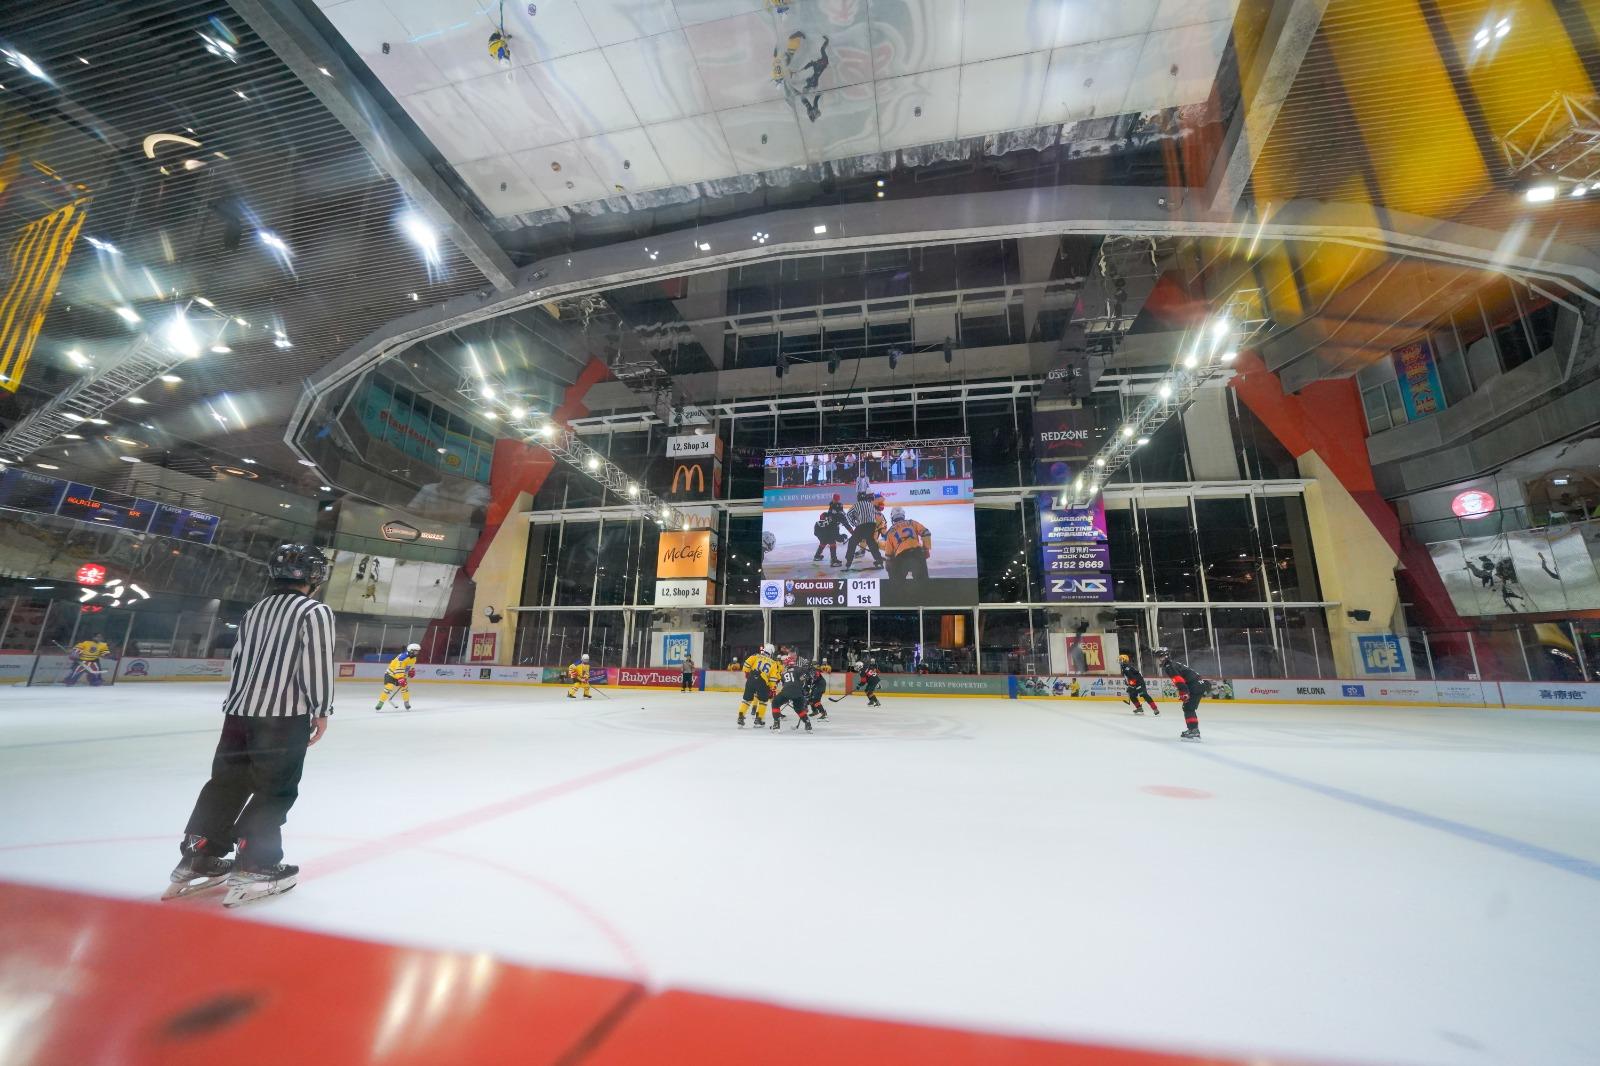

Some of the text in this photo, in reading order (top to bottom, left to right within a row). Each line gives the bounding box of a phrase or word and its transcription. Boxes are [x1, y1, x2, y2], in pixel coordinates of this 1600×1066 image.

[1041, 430, 1088, 440] REDZONE
[684, 442, 700, 451] Shop
[838, 581, 844, 590] 7
[852, 581, 876, 590] 01:11
[662, 588, 672, 596] L2,
[673, 588, 690, 598] Shop
[806, 596, 844, 605] KINGS 0
[857, 595, 872, 604] 1st
[758, 661, 771, 674] 16
[784, 672, 794, 682] 81
